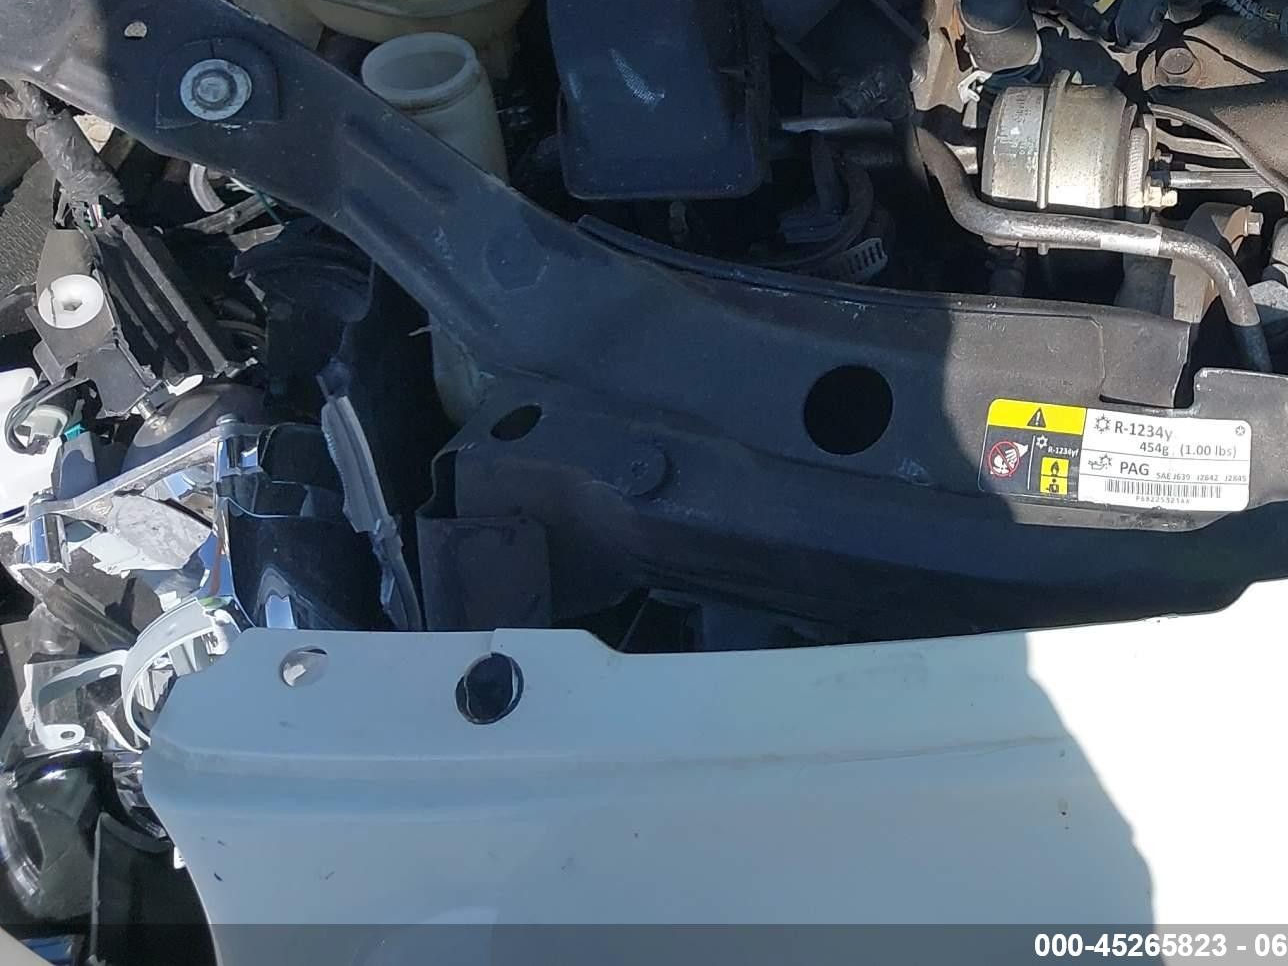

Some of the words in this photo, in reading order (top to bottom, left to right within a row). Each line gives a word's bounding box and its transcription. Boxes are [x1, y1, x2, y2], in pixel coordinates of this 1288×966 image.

[1047, 445, 1080, 458] R-1234yf
[1180, 444, 1212, 457] (1.00
[1215, 445, 1237, 458] lbs)
[1120, 461, 1150, 476] PAG
[1156, 472, 1171, 480] SAE
